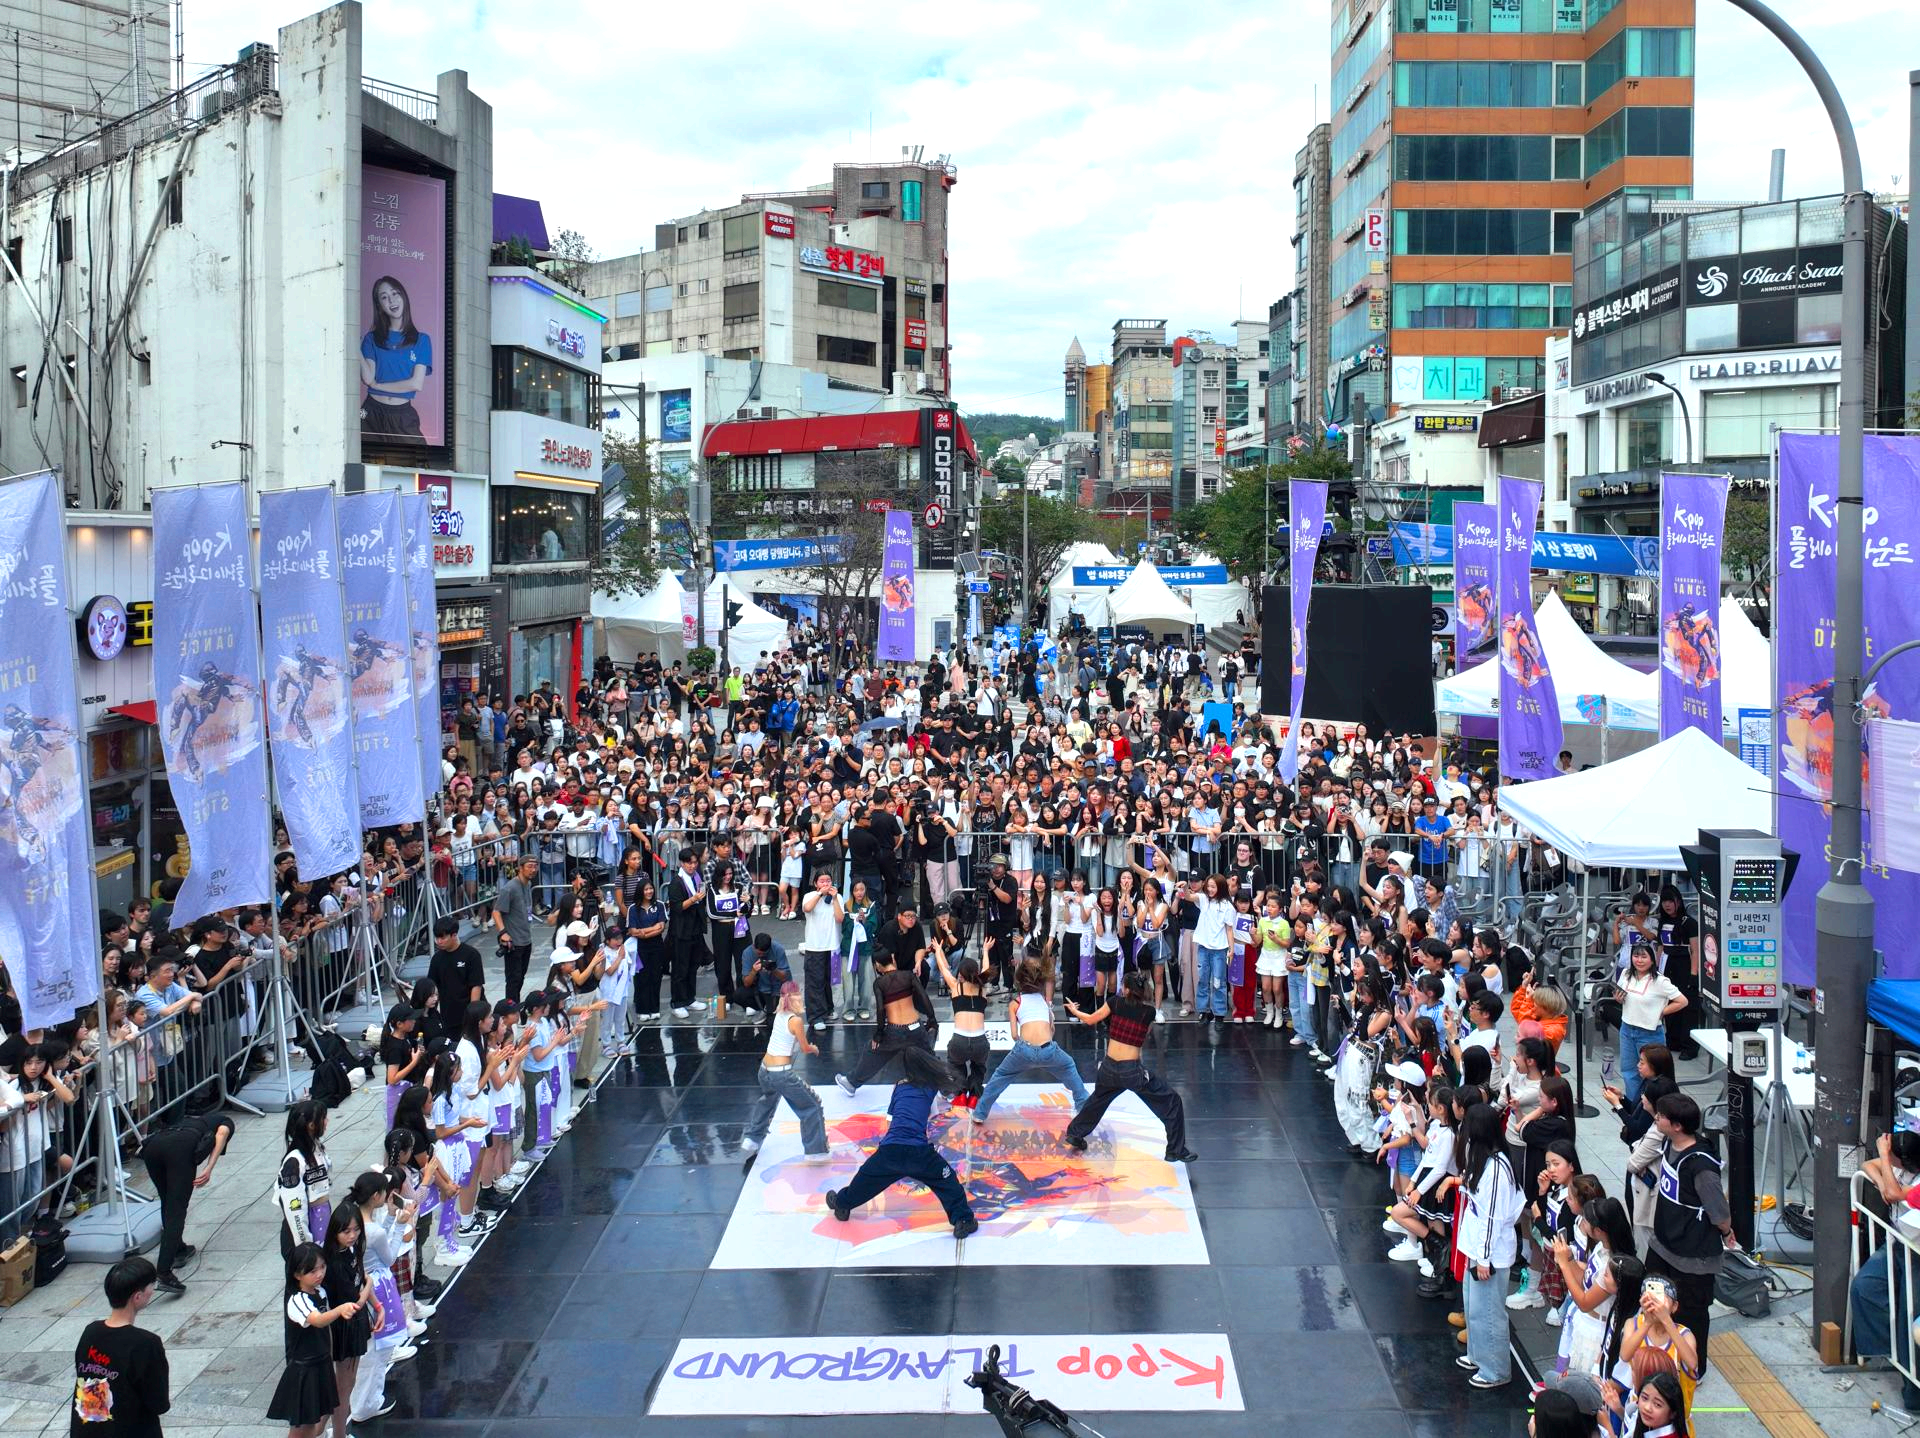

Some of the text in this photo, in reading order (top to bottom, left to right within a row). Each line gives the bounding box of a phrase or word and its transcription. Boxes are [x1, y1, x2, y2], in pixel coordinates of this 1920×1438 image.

[1626, 81, 1639, 90] 7F
[371, 191, 399, 209] 느낌
[372, 213, 401, 231] 감동
[824, 246, 855, 273] 형제
[857, 253, 885, 278] 갈비
[1740, 264, 1797, 286] Black
[1650, 277, 1679, 295] ANNOUNCER
[1760, 281, 1826, 293] ANNOUNCER ACADEMY
[1651, 291, 1673, 306] ACADEMY
[1587, 287, 1650, 332] 블랙스완스피치
[1428, 366, 1483, 393] 치과
[937, 414, 949, 423] 24
[1423, 416, 1446, 429] 한탑
[1446, 416, 1474, 427] 부동산
[1673, 503, 1704, 531] K-pop
[1560, 542, 1598, 561] 호랑이
[1465, 567, 1489, 578] DANCE
[721, 900, 734, 910] 49
[1733, 913, 1771, 923] 미세먼지
[1144, 921, 1154, 931] 16
[1738, 924, 1766, 934] 알리미
[1744, 1011, 1768, 1019] 서대문구
[1745, 1056, 1767, 1067] 4BLK
[1056, 1343, 1224, 1400] K-pop
